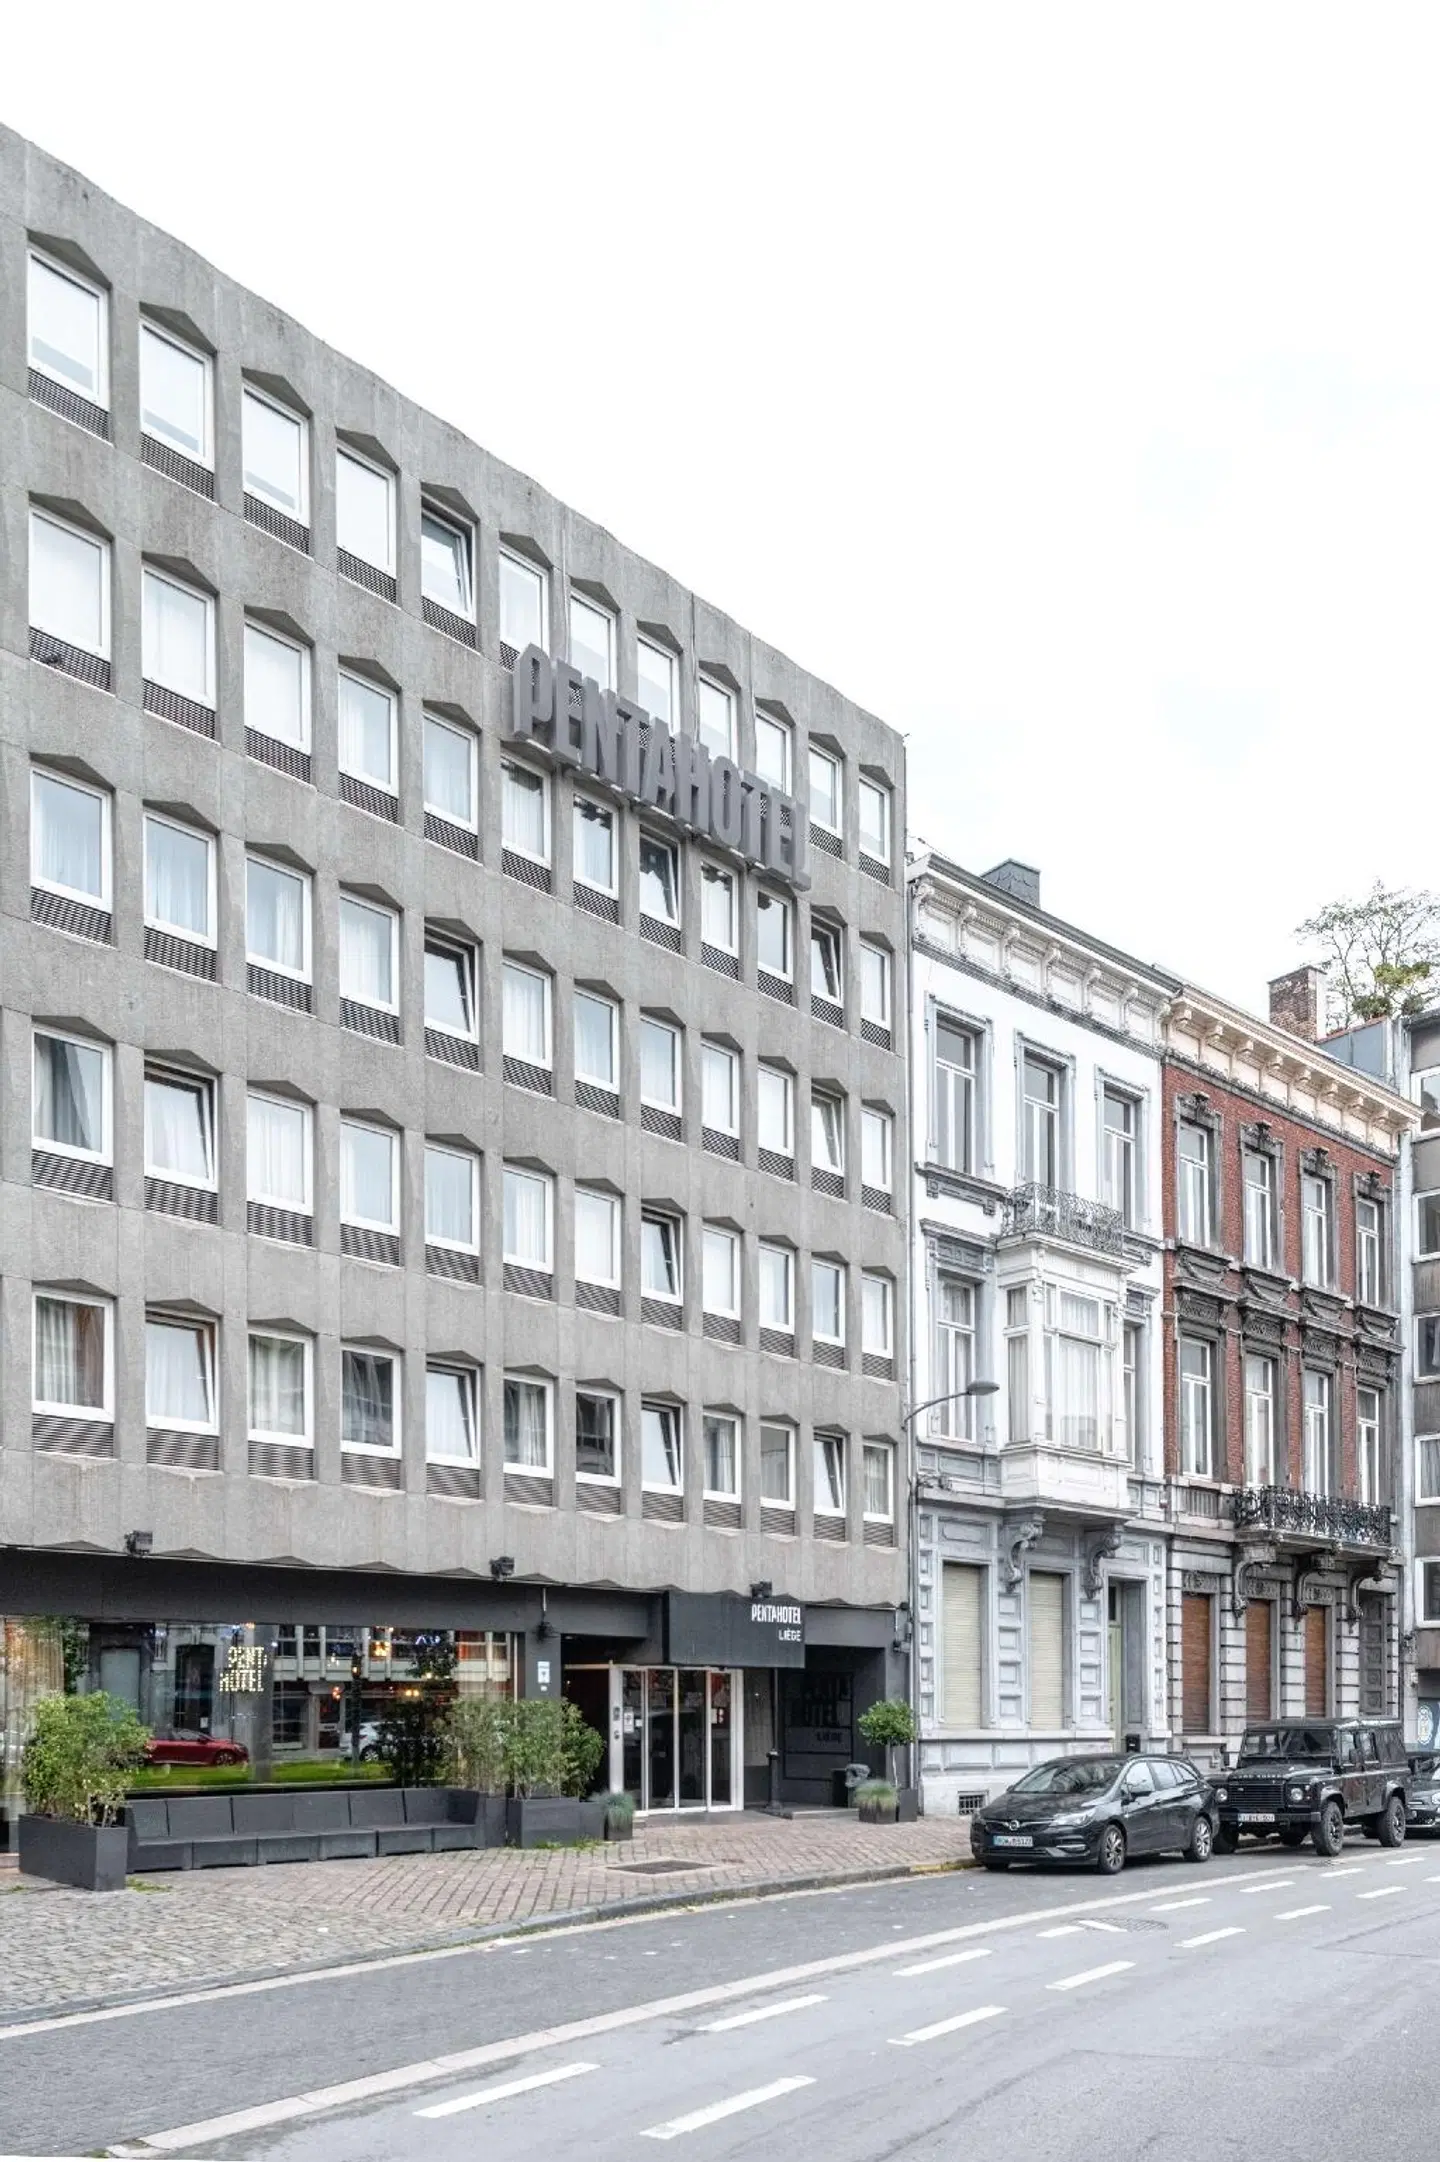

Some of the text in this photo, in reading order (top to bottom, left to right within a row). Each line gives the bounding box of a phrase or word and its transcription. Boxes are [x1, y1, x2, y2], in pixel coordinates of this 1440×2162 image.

[511, 642, 811, 892] PENTAHOTEL
[751, 1603, 801, 1624] PENTAHOTEL
[219, 1669, 265, 1692] HOTEL
